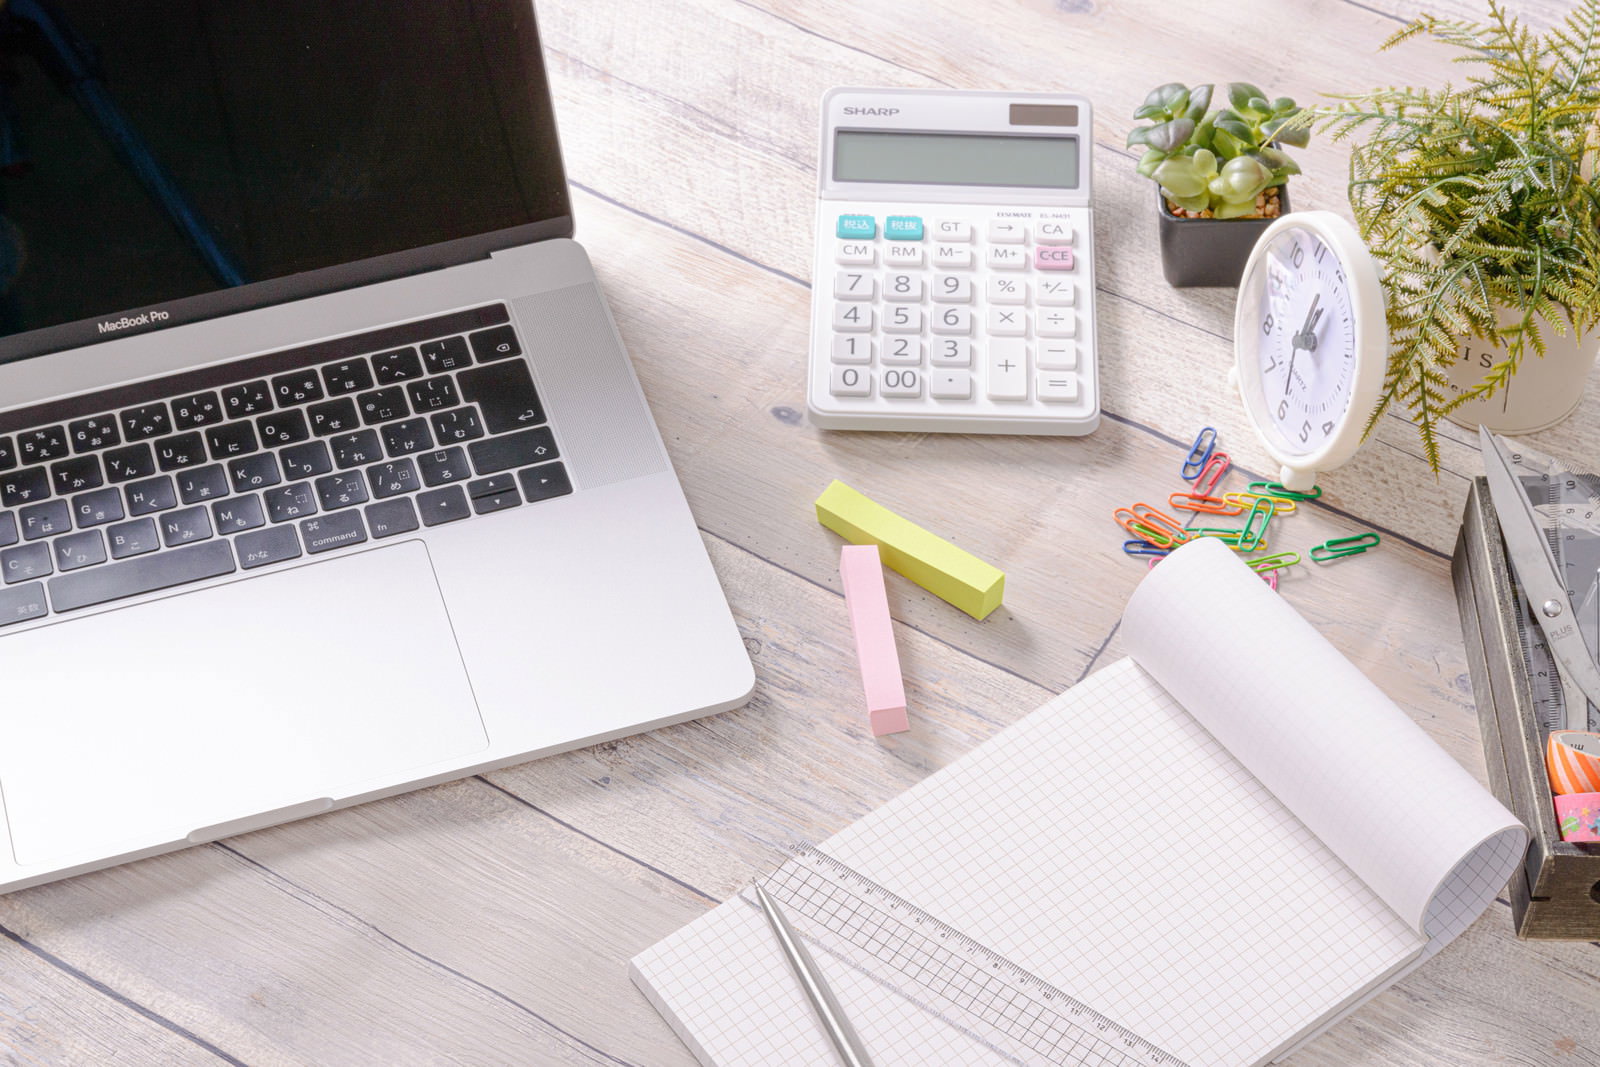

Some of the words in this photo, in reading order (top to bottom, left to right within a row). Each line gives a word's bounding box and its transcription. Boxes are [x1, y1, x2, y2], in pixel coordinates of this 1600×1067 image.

[843, 106, 900, 117] SHARP
[941, 222, 960, 231] GT
[1042, 224, 1063, 234] CA
[843, 245, 867, 255] CM
[892, 247, 915, 256] RM
[1289, 241, 1305, 269] 10
[1314, 241, 1327, 265] 11
[848, 274, 862, 291] 7
[895, 276, 910, 292] 8
[944, 277, 959, 293] 9
[843, 306, 860, 323] 4
[895, 307, 908, 324] 5
[944, 309, 959, 325] 6
[98, 315, 148, 333] MacBook
[150, 310, 169, 322] Pro
[1263, 313, 1275, 336] 8
[847, 338, 855, 354] 1
[893, 339, 908, 356] 2
[944, 340, 958, 357] 3
[1264, 355, 1277, 374] 7
[842, 369, 858, 386] 0
[885, 371, 916, 388] 00
[230, 397, 239, 406] 9
[180, 409, 189, 417] 8
[1277, 400, 1289, 421] 6
[129, 420, 136, 428] 7
[316, 415, 324, 424] P
[1299, 420, 1312, 443] 5
[1322, 420, 1336, 437] 4
[77, 432, 86, 440] 6
[26, 443, 34, 451] 5
[163, 449, 173, 458] U
[111, 461, 119, 469] Y
[288, 459, 296, 467] L
[59, 472, 68, 481] T
[237, 470, 246, 479] K
[6, 484, 16, 493] R
[187, 482, 193, 491] J
[134, 493, 144, 502] H
[81, 505, 91, 514] G
[221, 511, 232, 520] M
[28, 517, 35, 526] F
[169, 523, 179, 533] N
[377, 523, 387, 532] fn
[116, 536, 125, 544] B
[312, 531, 356, 546] command
[62, 548, 72, 557] V
[247, 550, 269, 562] かな
[8, 560, 18, 570] C
[1043, 992, 1052, 1000] 10
